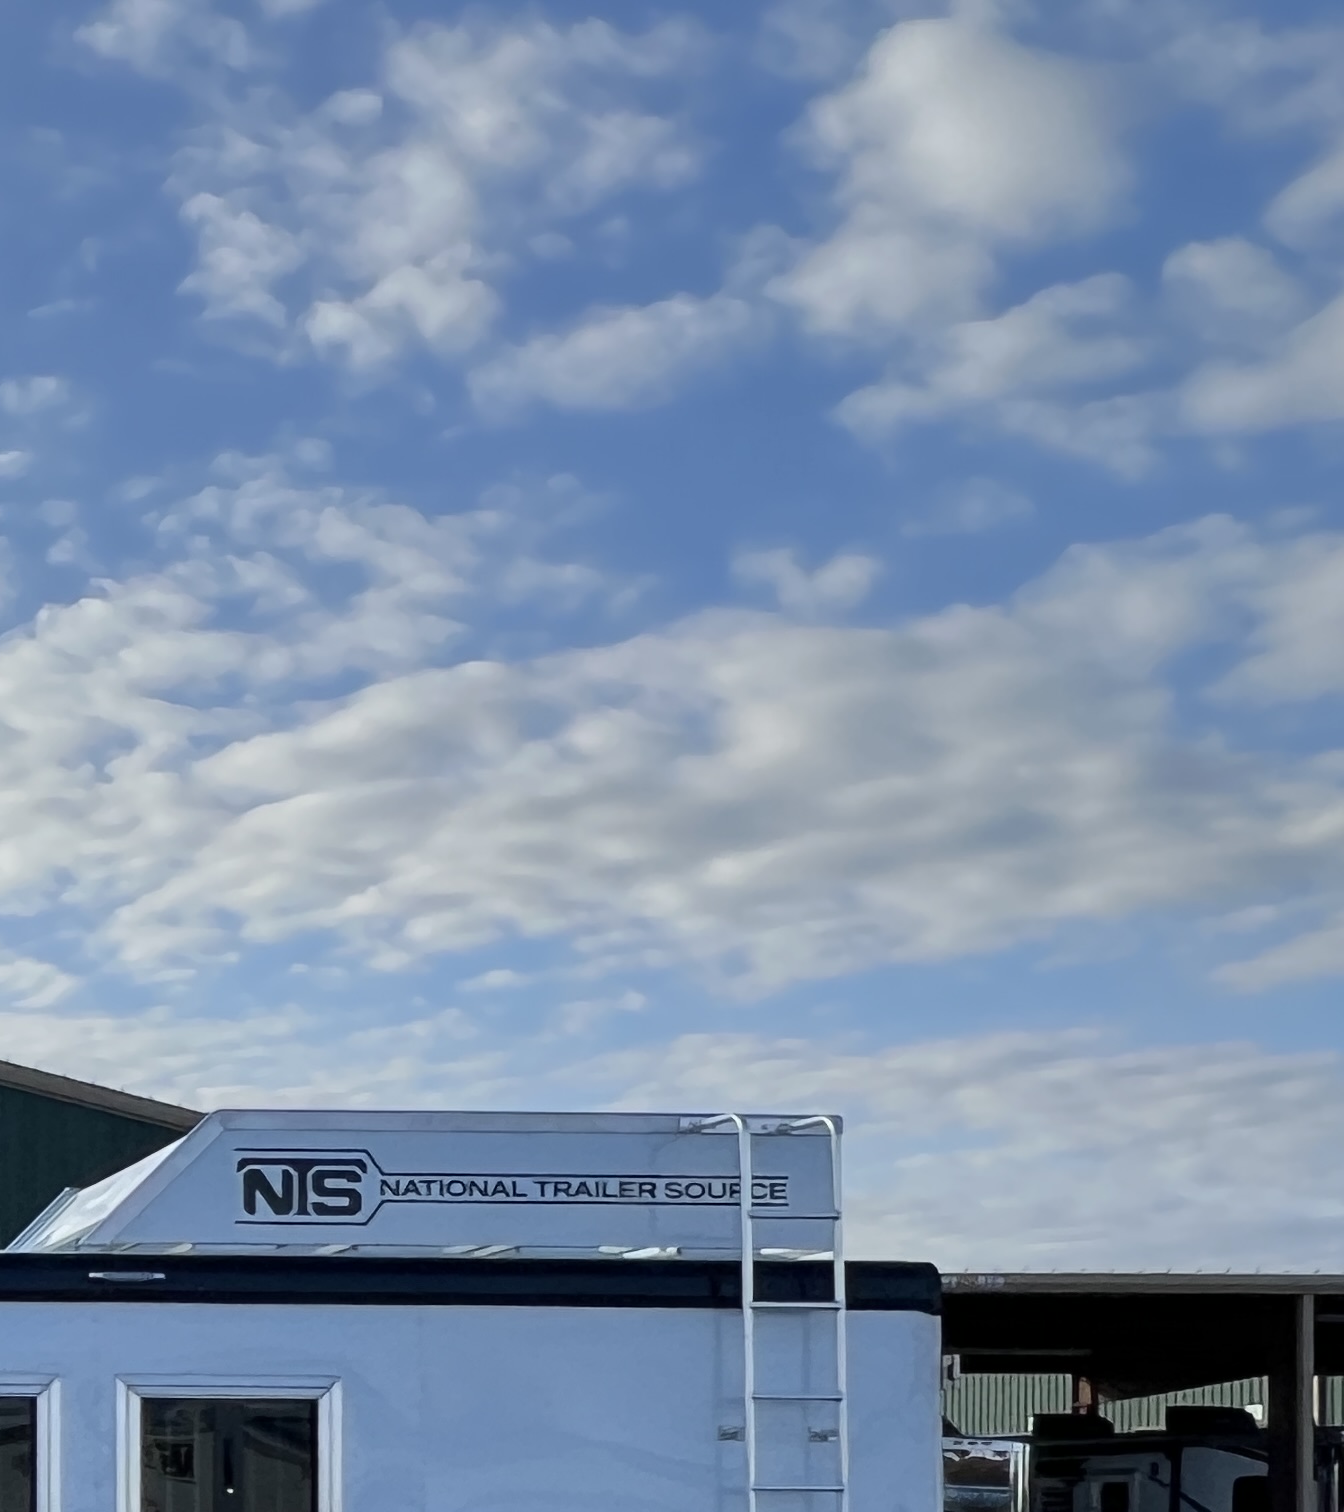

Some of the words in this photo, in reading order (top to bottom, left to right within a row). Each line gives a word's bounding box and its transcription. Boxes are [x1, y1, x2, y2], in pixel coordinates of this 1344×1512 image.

[237, 1158, 368, 1217] NTS
[379, 1179, 528, 1197] NATIONAL
[533, 1180, 657, 1199] TRAILER
